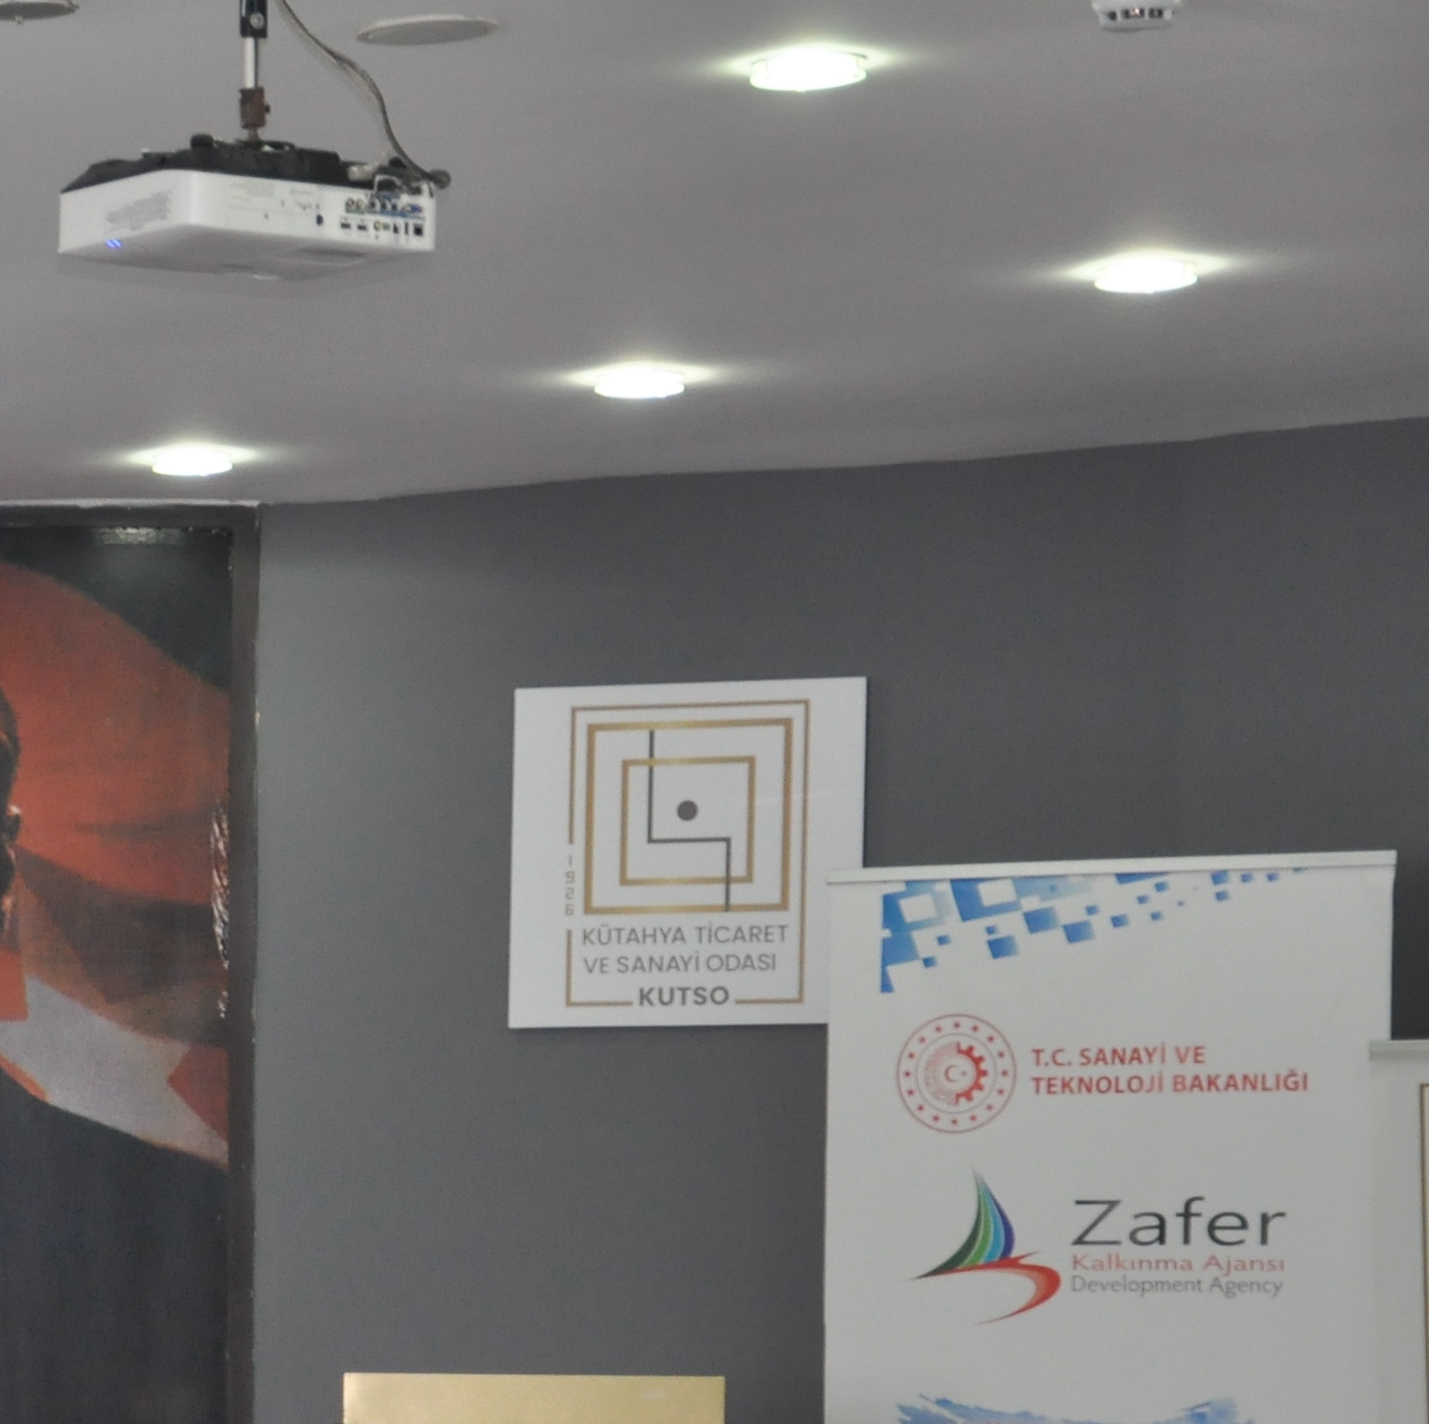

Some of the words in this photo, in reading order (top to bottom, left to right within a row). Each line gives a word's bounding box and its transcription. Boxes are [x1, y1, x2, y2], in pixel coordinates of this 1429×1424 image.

[581, 924, 688, 947] KÜTAHYA
[694, 920, 791, 945] TİCARET
[583, 956, 610, 974] VE
[616, 950, 701, 974] SANAYİ
[706, 952, 778, 972] ODASI
[638, 985, 731, 1007] KUTSO
[1031, 1048, 1073, 1068] T.C.
[1078, 1042, 1169, 1067] SANAYİ
[1174, 1044, 1207, 1066] VE
[1031, 1071, 1166, 1096] TEKNOLOJİ
[1172, 1068, 1310, 1095] BAKANLIĞI
[1070, 1195, 1288, 1248] Zafer
[1071, 1252, 1195, 1273] Kalkınma
[1202, 1252, 1287, 1278] Ajansı
[1070, 1274, 1204, 1298] Development
[1208, 1275, 1285, 1298] Agency
